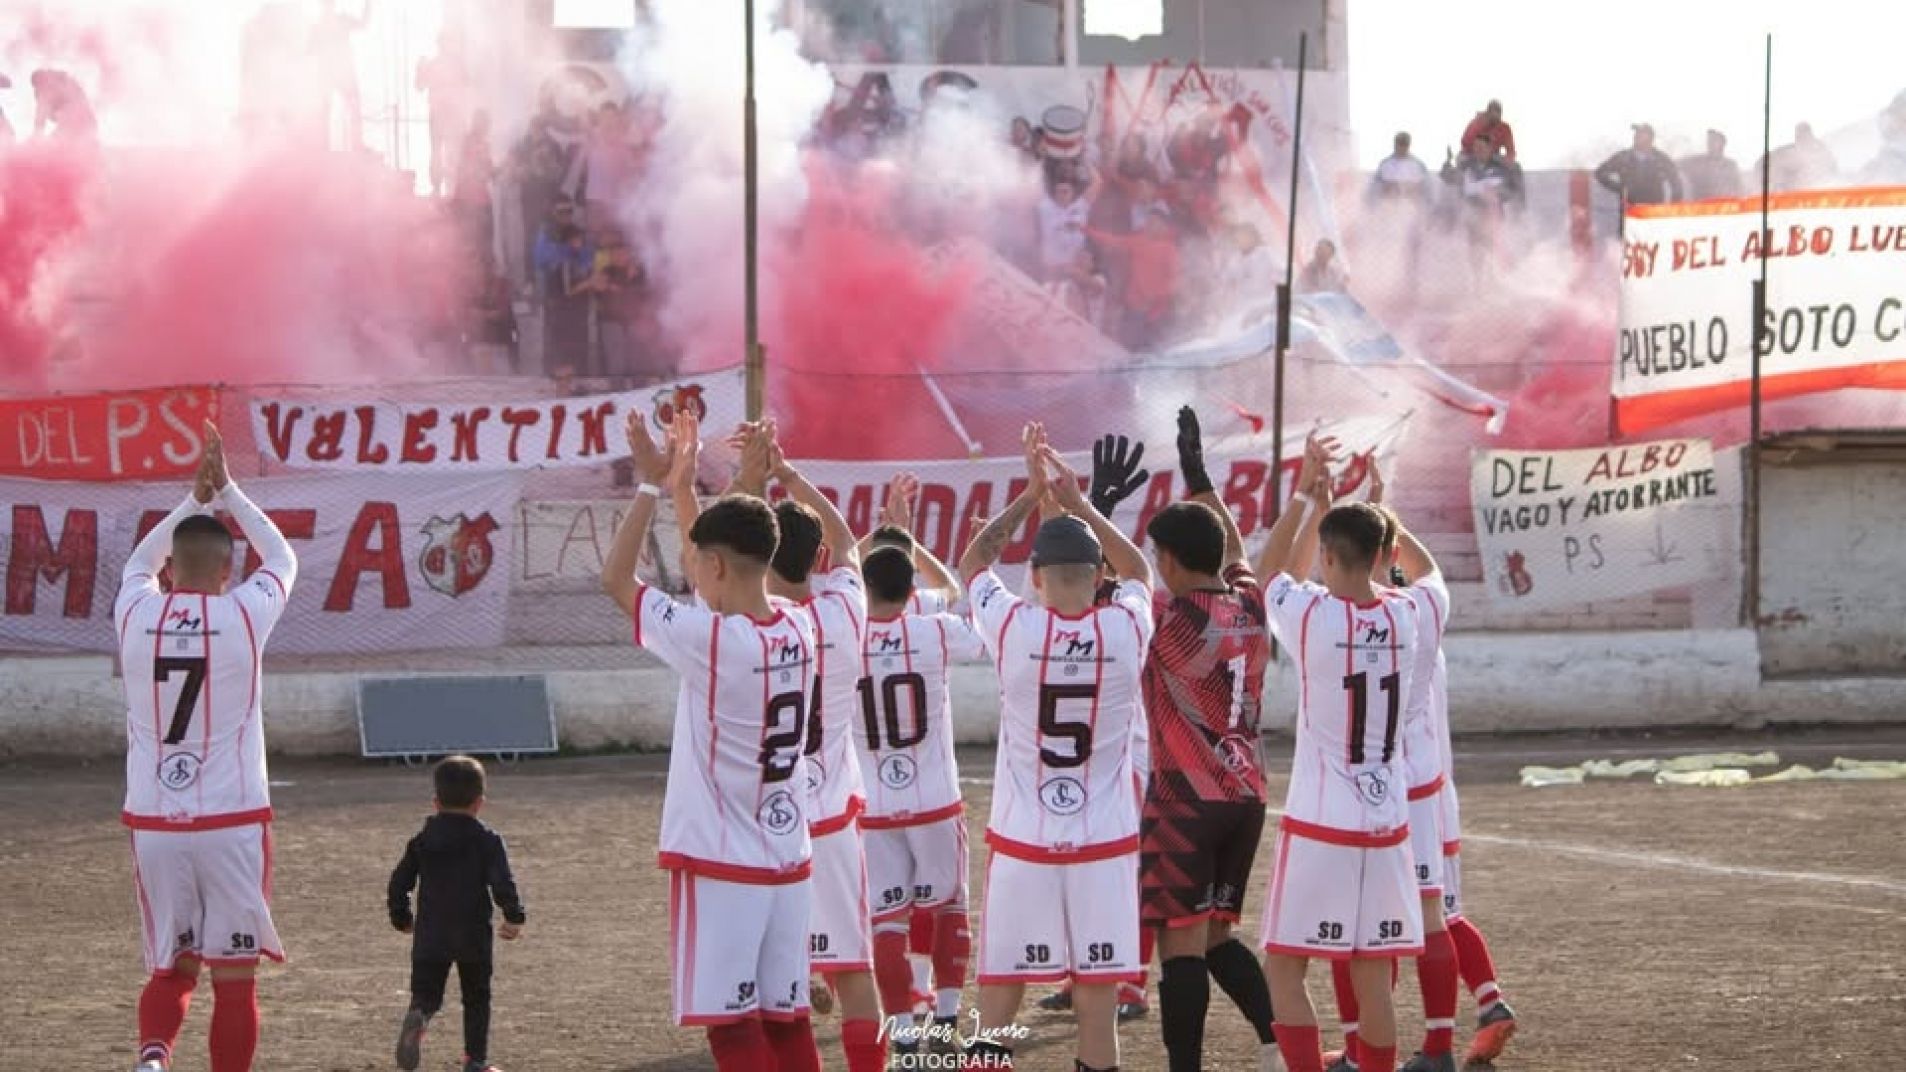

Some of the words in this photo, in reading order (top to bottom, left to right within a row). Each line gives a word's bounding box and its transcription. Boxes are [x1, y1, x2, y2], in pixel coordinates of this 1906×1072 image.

[1671, 236, 1726, 272] DEL
[1620, 315, 1728, 381] PUEBLO
[17, 405, 93, 466] DEL
[1491, 455, 1564, 498] DEL
[1583, 442, 1687, 485] ALBO
[1483, 504, 1550, 535] VAGO
[154, 657, 208, 744] 7
[857, 672, 928, 751] 10
[1226, 653, 1246, 729] 1
[1343, 671, 1400, 764] 11
[1038, 683, 1098, 768] 5
[232, 933, 255, 949] SD
[1025, 944, 1050, 963] SD
[1088, 942, 1114, 962] SD
[1318, 921, 1343, 940] SD
[1380, 921, 1403, 938] SD
